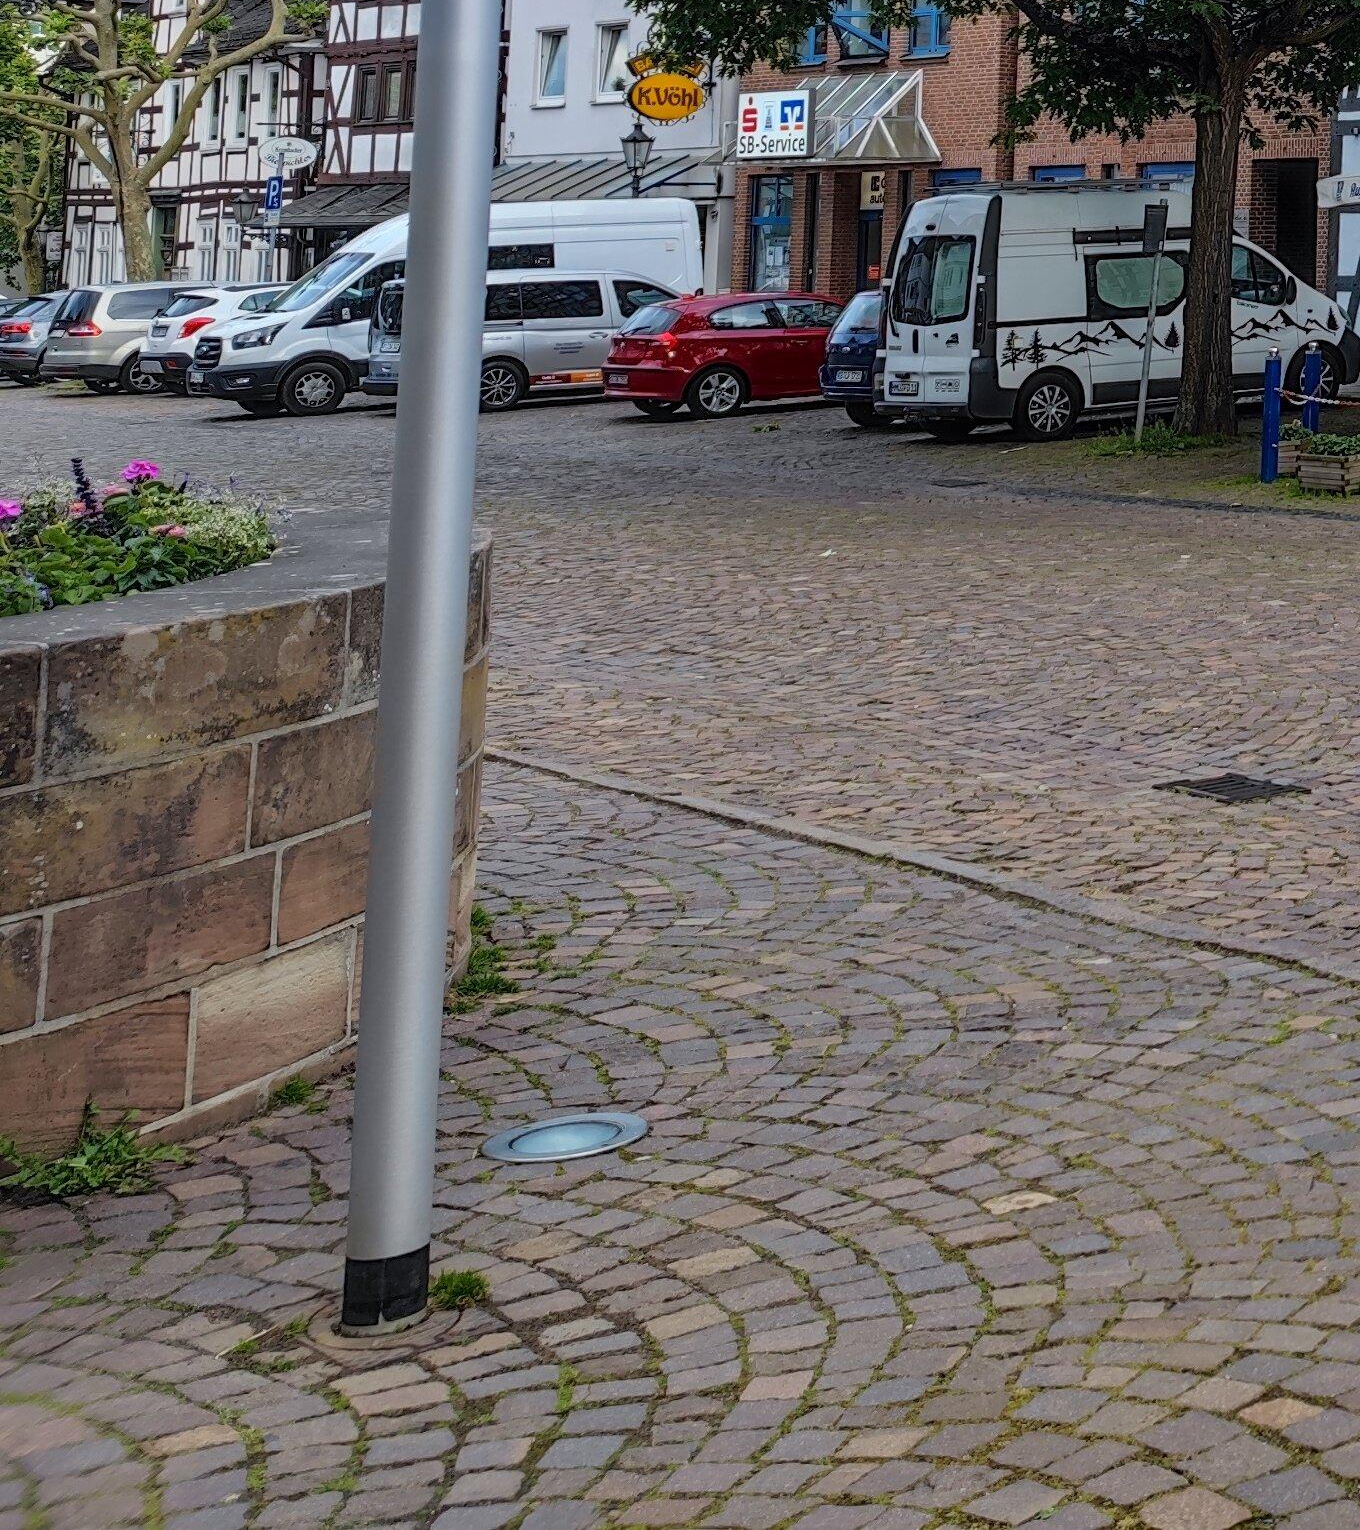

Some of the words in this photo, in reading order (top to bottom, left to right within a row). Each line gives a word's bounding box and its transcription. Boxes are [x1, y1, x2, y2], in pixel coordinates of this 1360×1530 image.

[637, 86, 699, 112] K.Vöhl
[739, 134, 805, 154] SB-Service
[269, 180, 279, 206] P
